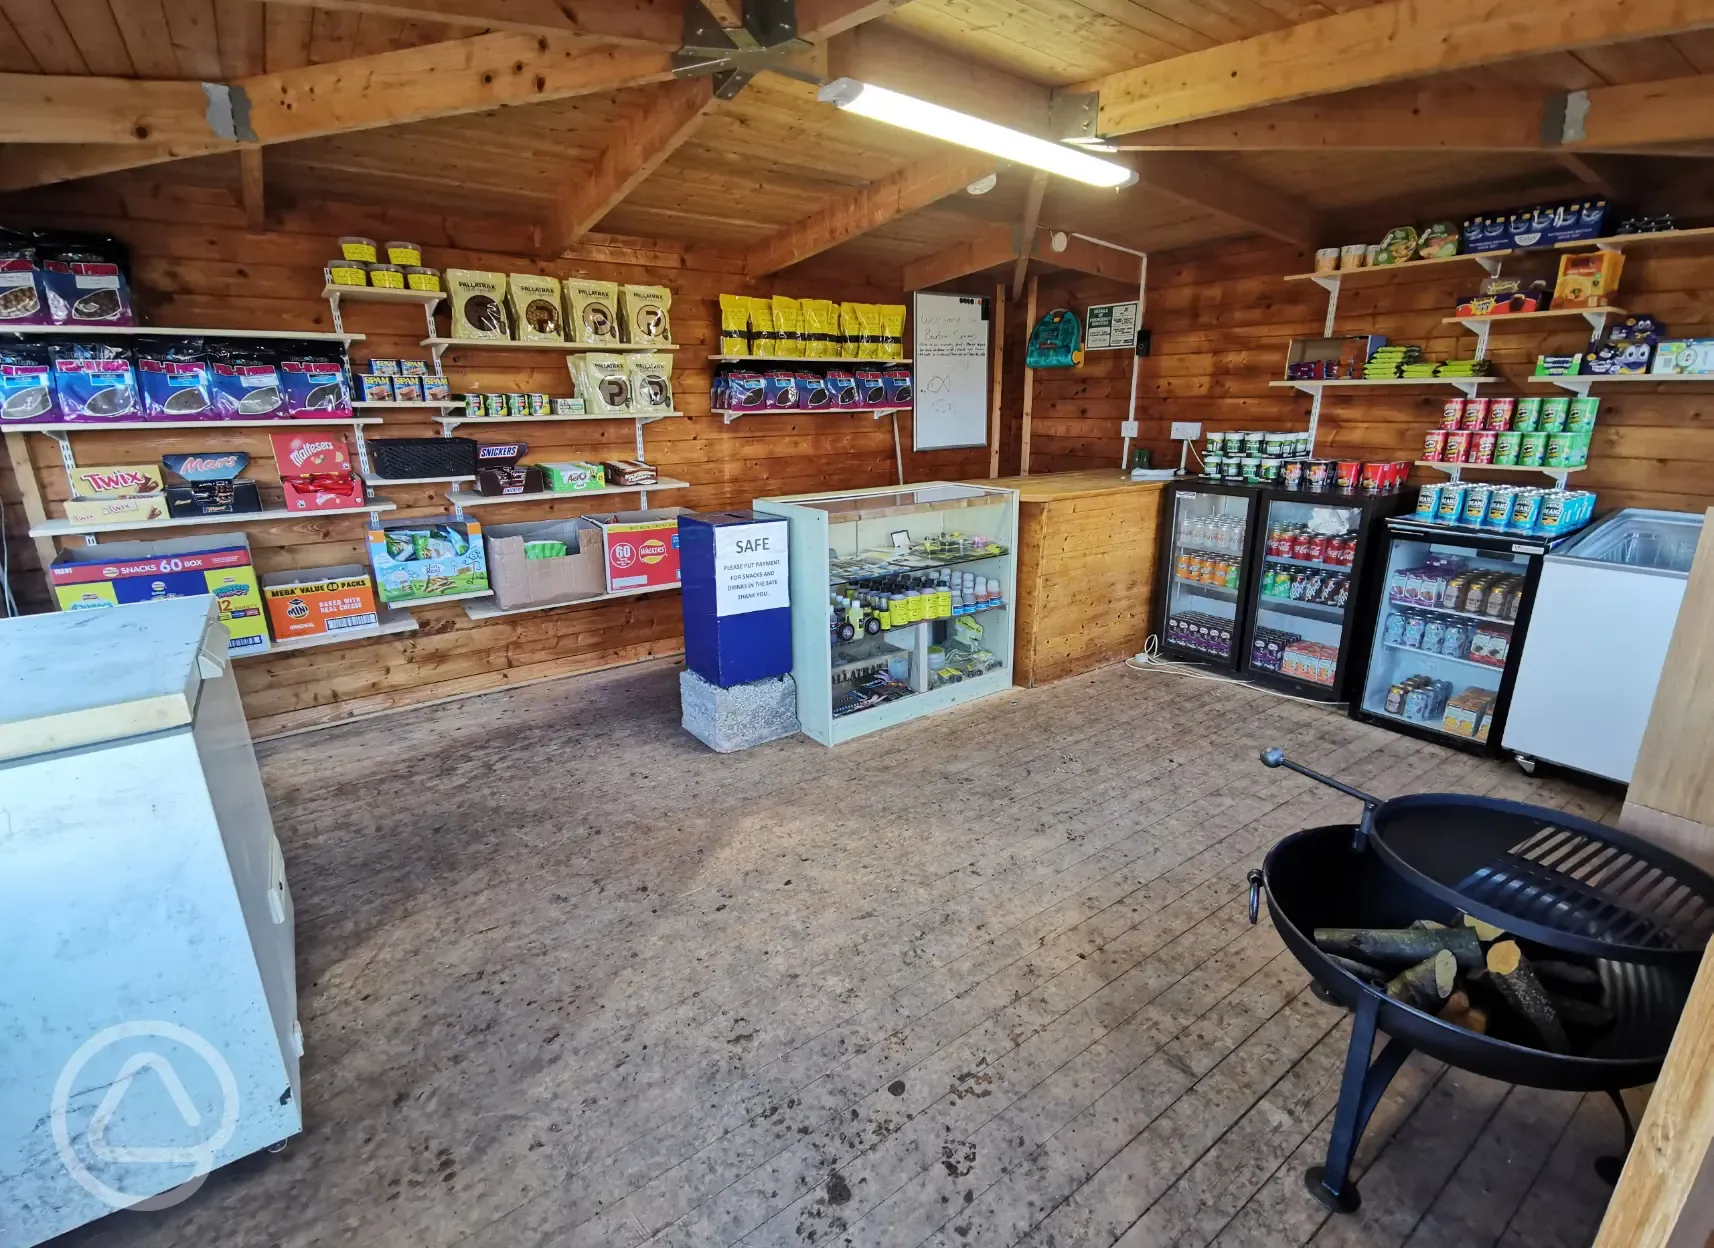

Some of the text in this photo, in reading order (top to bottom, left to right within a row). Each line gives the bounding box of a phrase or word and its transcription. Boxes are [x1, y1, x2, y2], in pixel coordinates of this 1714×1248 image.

[634, 292, 664, 300] PALLATRAX
[290, 442, 334, 467] Maltesers
[480, 446, 517, 457] SNICKERS
[180, 456, 238, 474] Mars
[616, 546, 631, 558] 60
[736, 538, 770, 554] SAFE
[121, 564, 156, 574] SNACKS
[160, 559, 182, 573] 60
[300, 584, 325, 594] VALUE
[341, 580, 366, 588] PACKS
[217, 600, 232, 612] 12
[320, 599, 342, 608] BAKED
[340, 603, 362, 611] CHEESE
[288, 605, 308, 617] MINI
